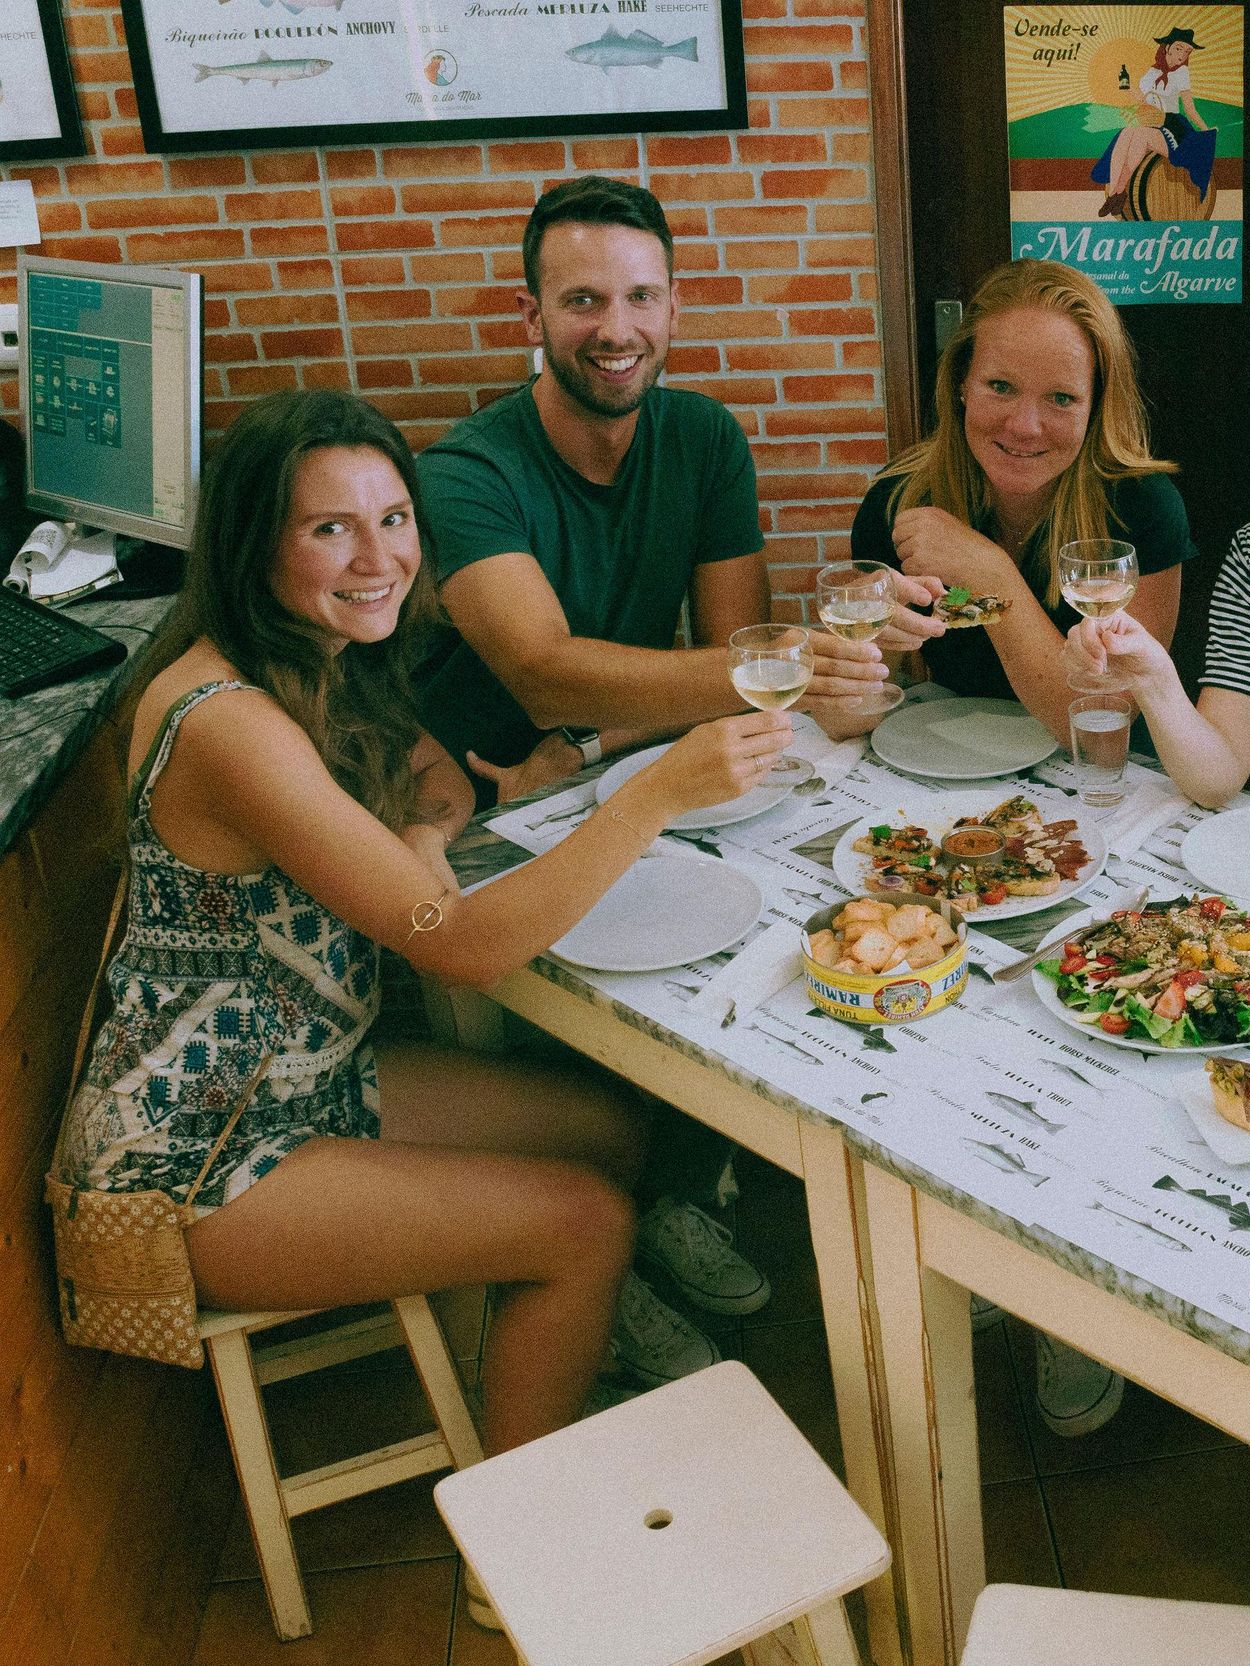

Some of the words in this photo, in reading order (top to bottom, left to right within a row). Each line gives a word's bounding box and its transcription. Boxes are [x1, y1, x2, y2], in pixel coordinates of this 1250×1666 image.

[464, 4, 529, 18] Pescada
[618, 0, 648, 13] HAKE
[165, 28, 248, 47] Biqueirão
[345, 21, 396, 36] ANCHOVY
[1014, 18, 1099, 37] Vende-se
[1032, 42, 1082, 67] aqui!
[457, 90, 481, 104] Mar
[1019, 225, 1240, 274] Marafada
[1139, 271, 1238, 299] Algarve
[898, 1026, 928, 1043] CODFISH
[1047, 1091, 1073, 1108] TROUT
[1018, 1136, 1042, 1151] HAKE
